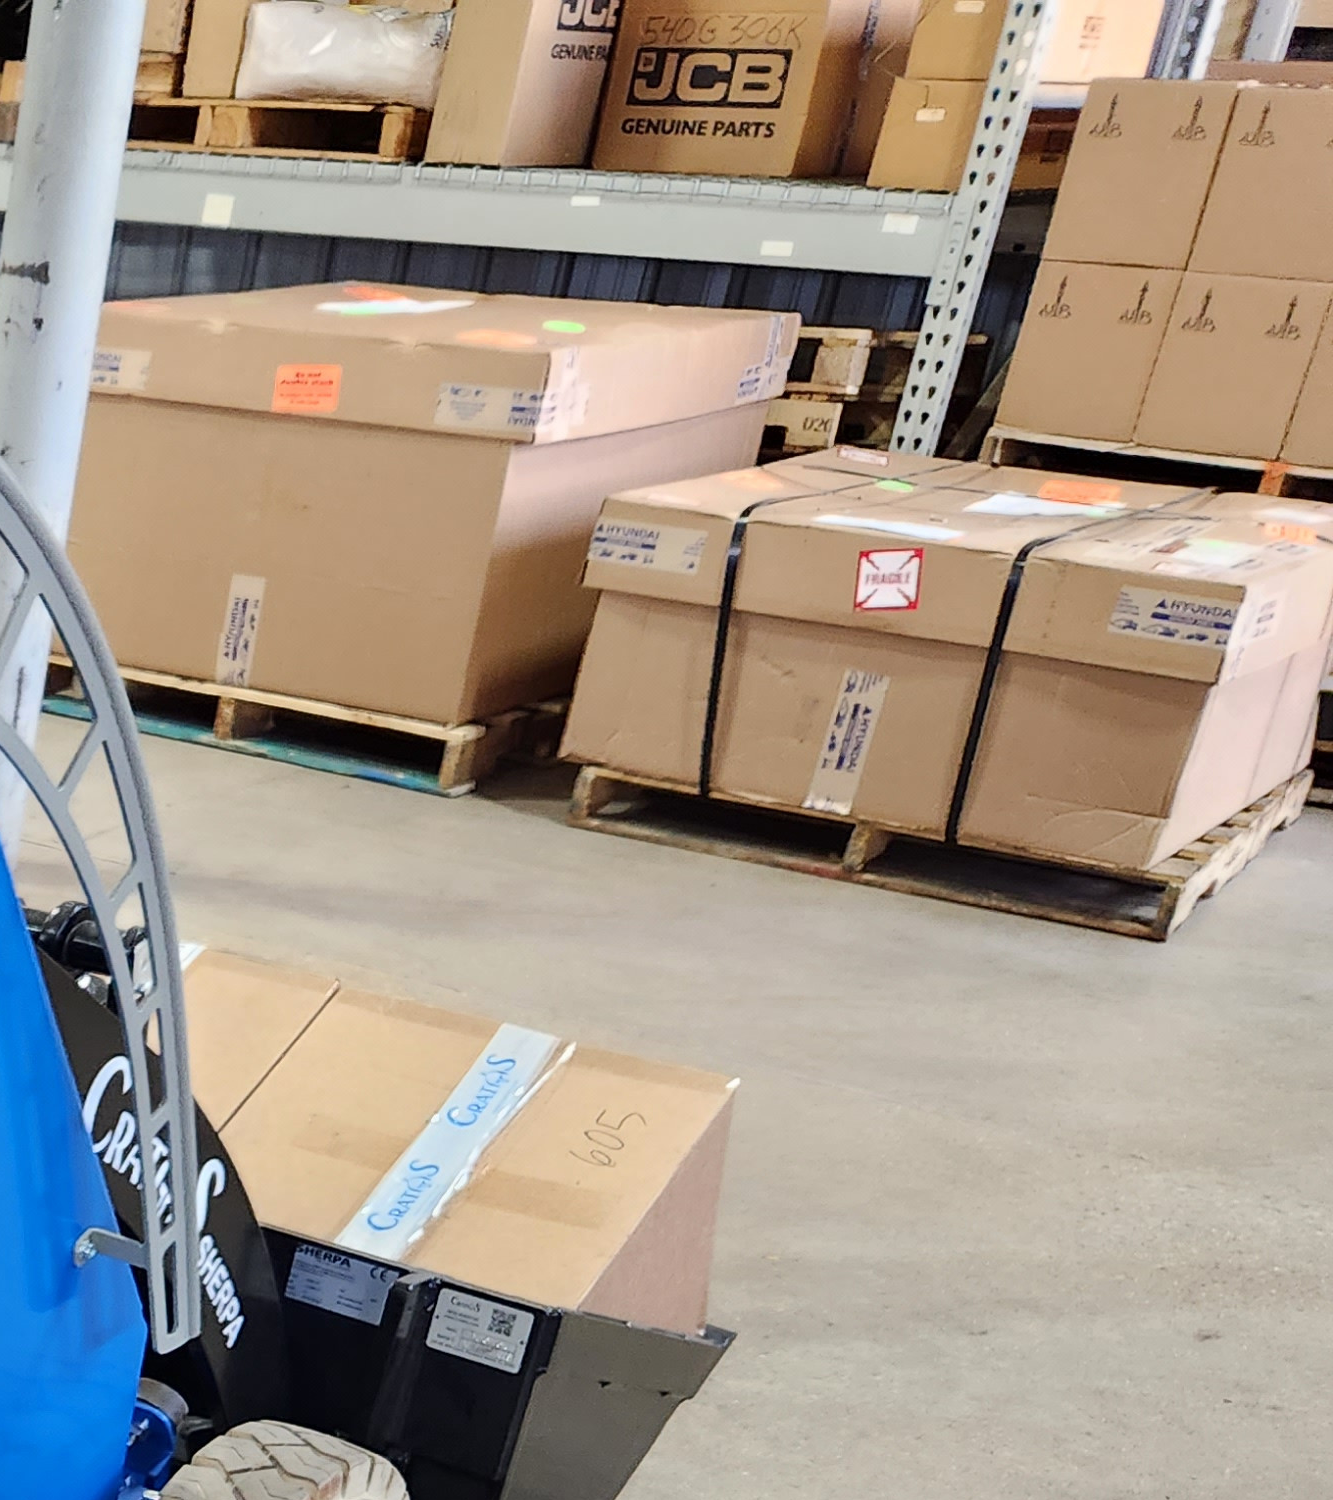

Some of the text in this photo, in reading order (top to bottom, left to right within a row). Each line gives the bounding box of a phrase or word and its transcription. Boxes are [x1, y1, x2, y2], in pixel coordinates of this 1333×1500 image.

[558, 0, 617, 28] JC
[633, 51, 789, 104] JCB
[621, 117, 776, 139] GENUINE PARTS
[606, 523, 661, 540] HYUNDAI
[865, 572, 911, 585] FRAGILE
[446, 1053, 517, 1128] CRATOS
[568, 1108, 647, 1169] 605
[366, 1158, 440, 1232] CRATOS
[198, 1234, 245, 1349] SHERPA
